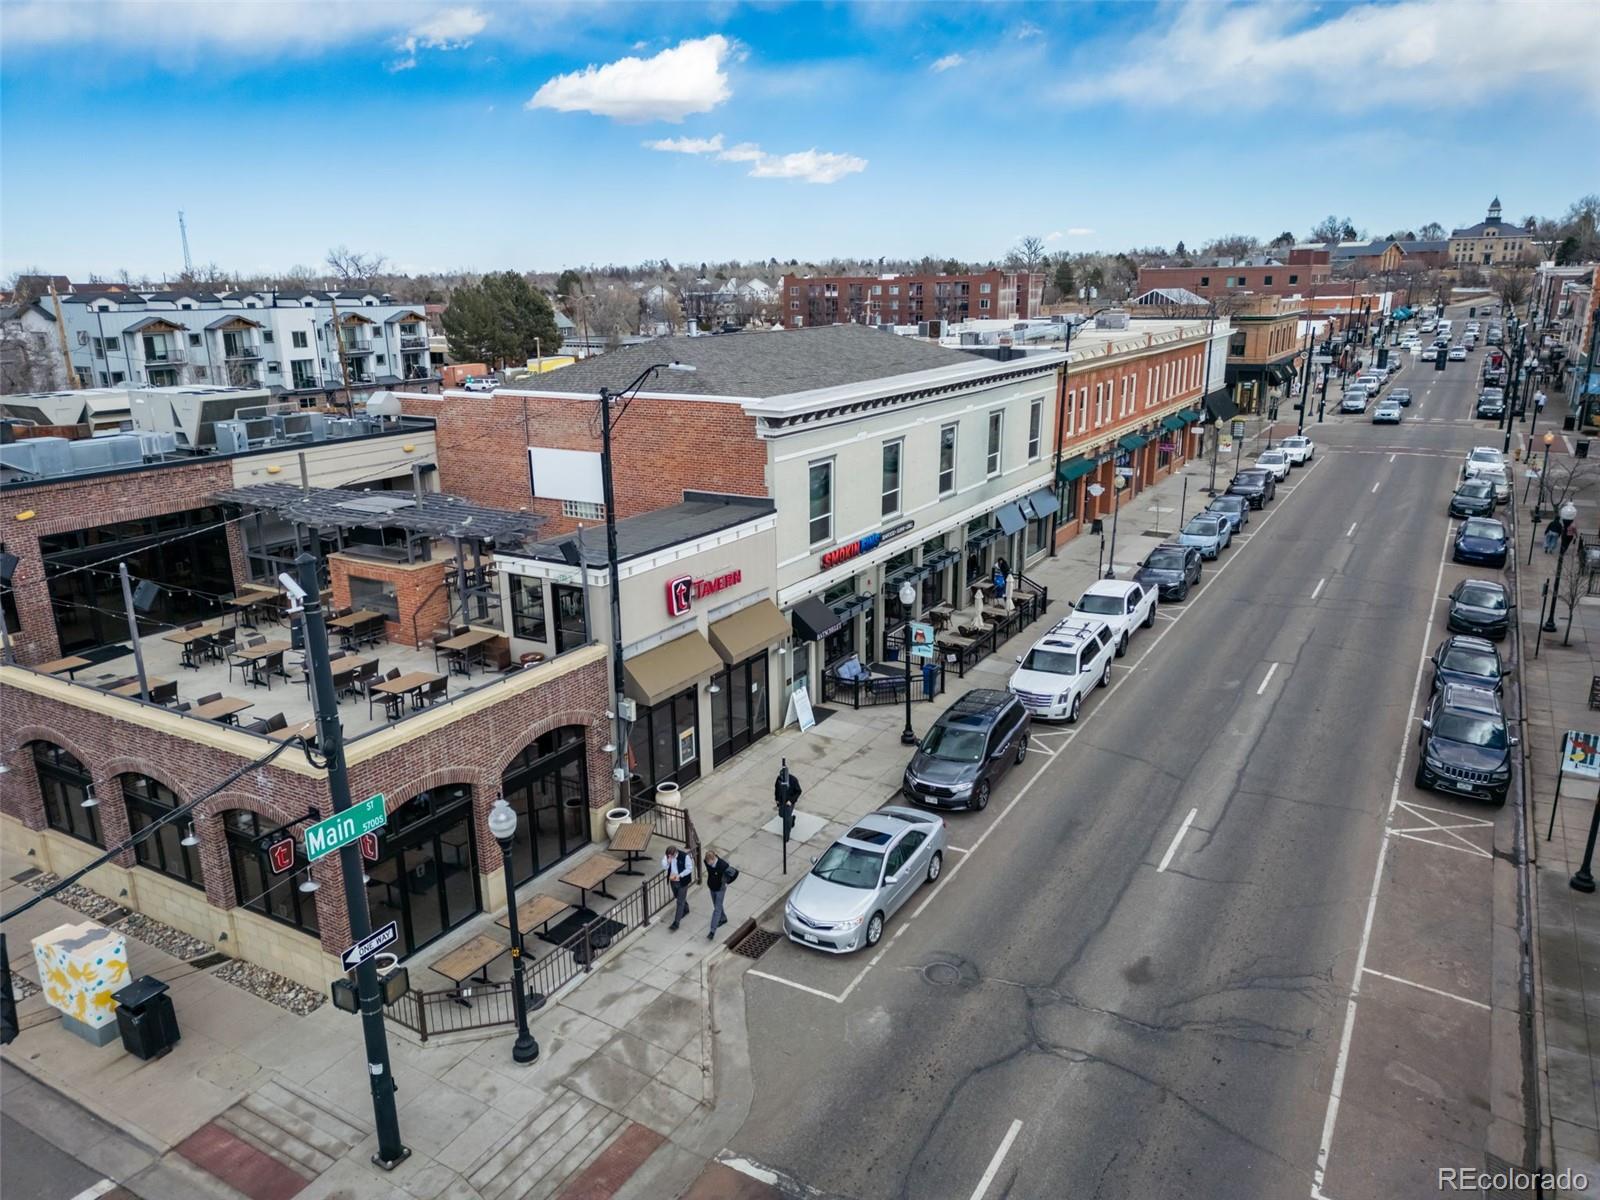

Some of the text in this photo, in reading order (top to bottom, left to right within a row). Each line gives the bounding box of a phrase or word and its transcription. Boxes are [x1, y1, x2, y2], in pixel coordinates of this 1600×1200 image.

[822, 540, 860, 569] SMOKIN
[693, 570, 741, 599] TAVERN
[308, 801, 374, 855] Main ST
[359, 930, 391, 956] ONE WAY
